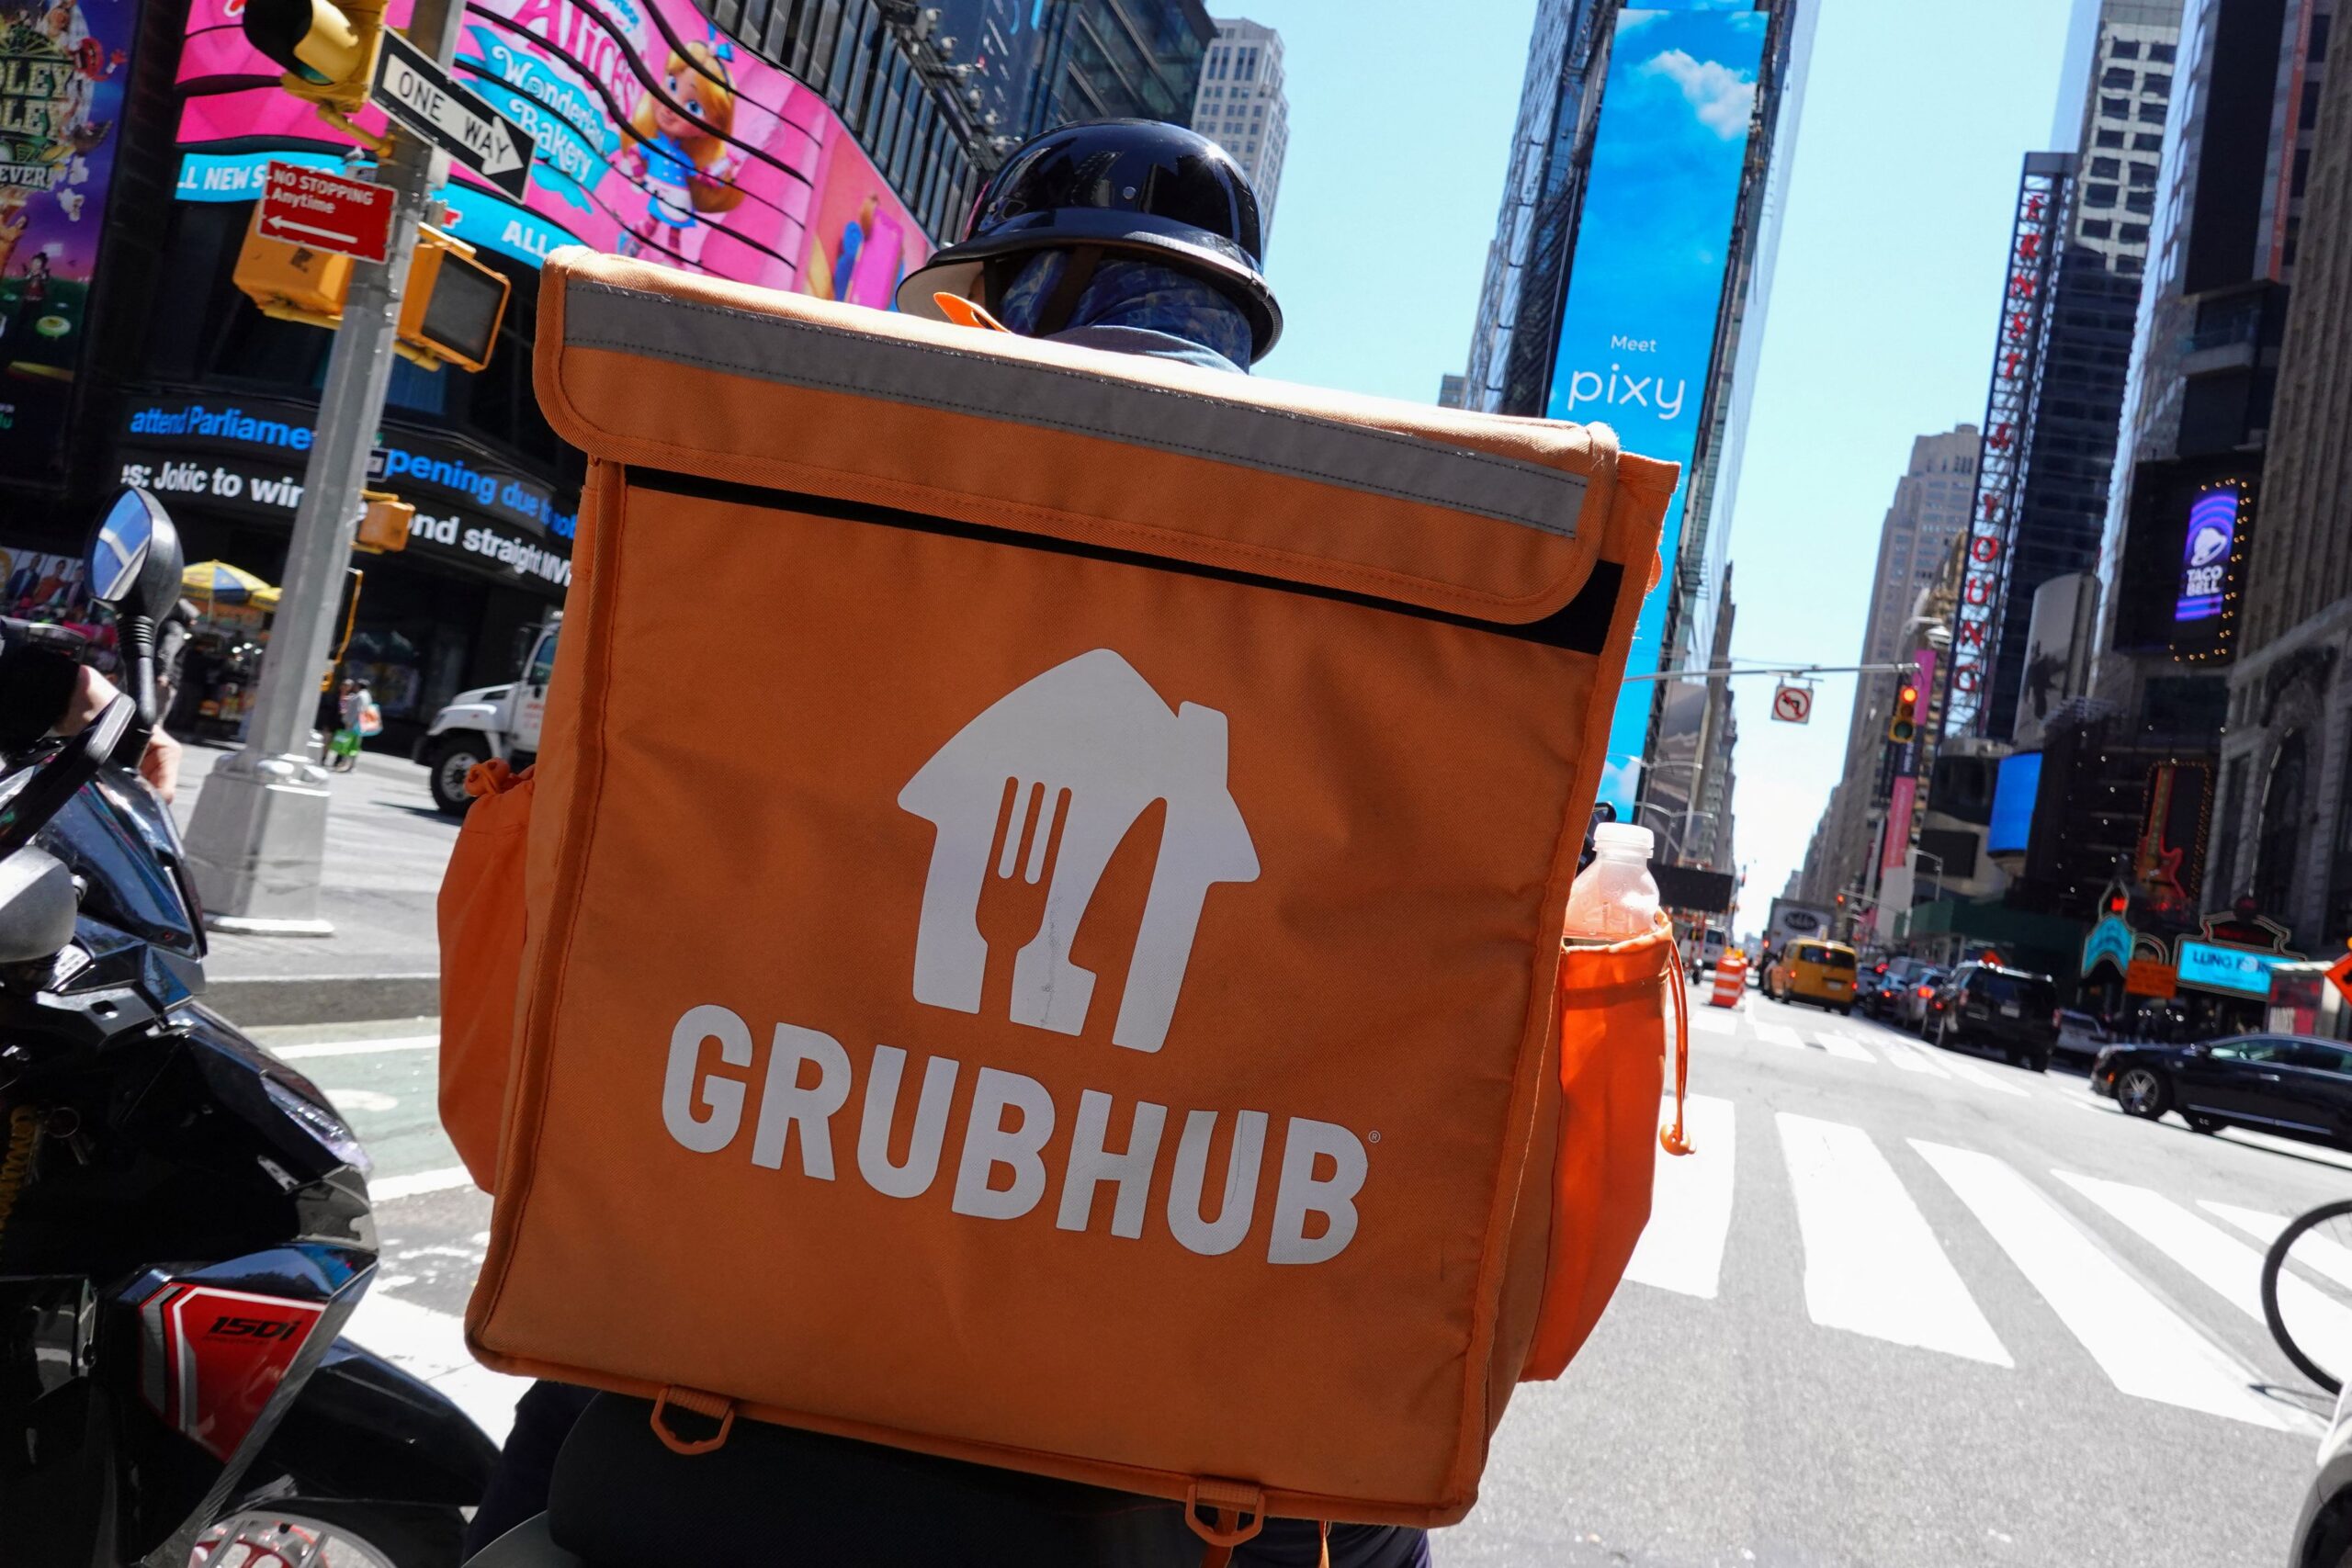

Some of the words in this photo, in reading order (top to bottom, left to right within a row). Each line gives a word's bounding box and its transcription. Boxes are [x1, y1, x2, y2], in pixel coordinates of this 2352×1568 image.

[399, 70, 446, 124] ONE
[464, 116, 512, 164] WAY
[507, 98, 593, 183] Bakery
[203, 166, 252, 191] NEW
[271, 186, 337, 214] Anytime
[274, 168, 297, 186] NO
[299, 173, 375, 207] STOPPING
[1611, 334, 1657, 353] Meet
[1567, 363, 1686, 421] pixy
[130, 407, 187, 435] attend
[187, 405, 313, 451] Parliame
[384, 448, 499, 505] pening
[501, 481, 540, 517] due
[153, 461, 208, 493] Jokic
[211, 467, 243, 498] to
[462, 526, 541, 574] straight
[1953, 492, 2001, 693] YOUNG
[2186, 565, 2223, 583] TACO
[2186, 580, 2222, 597] BELL
